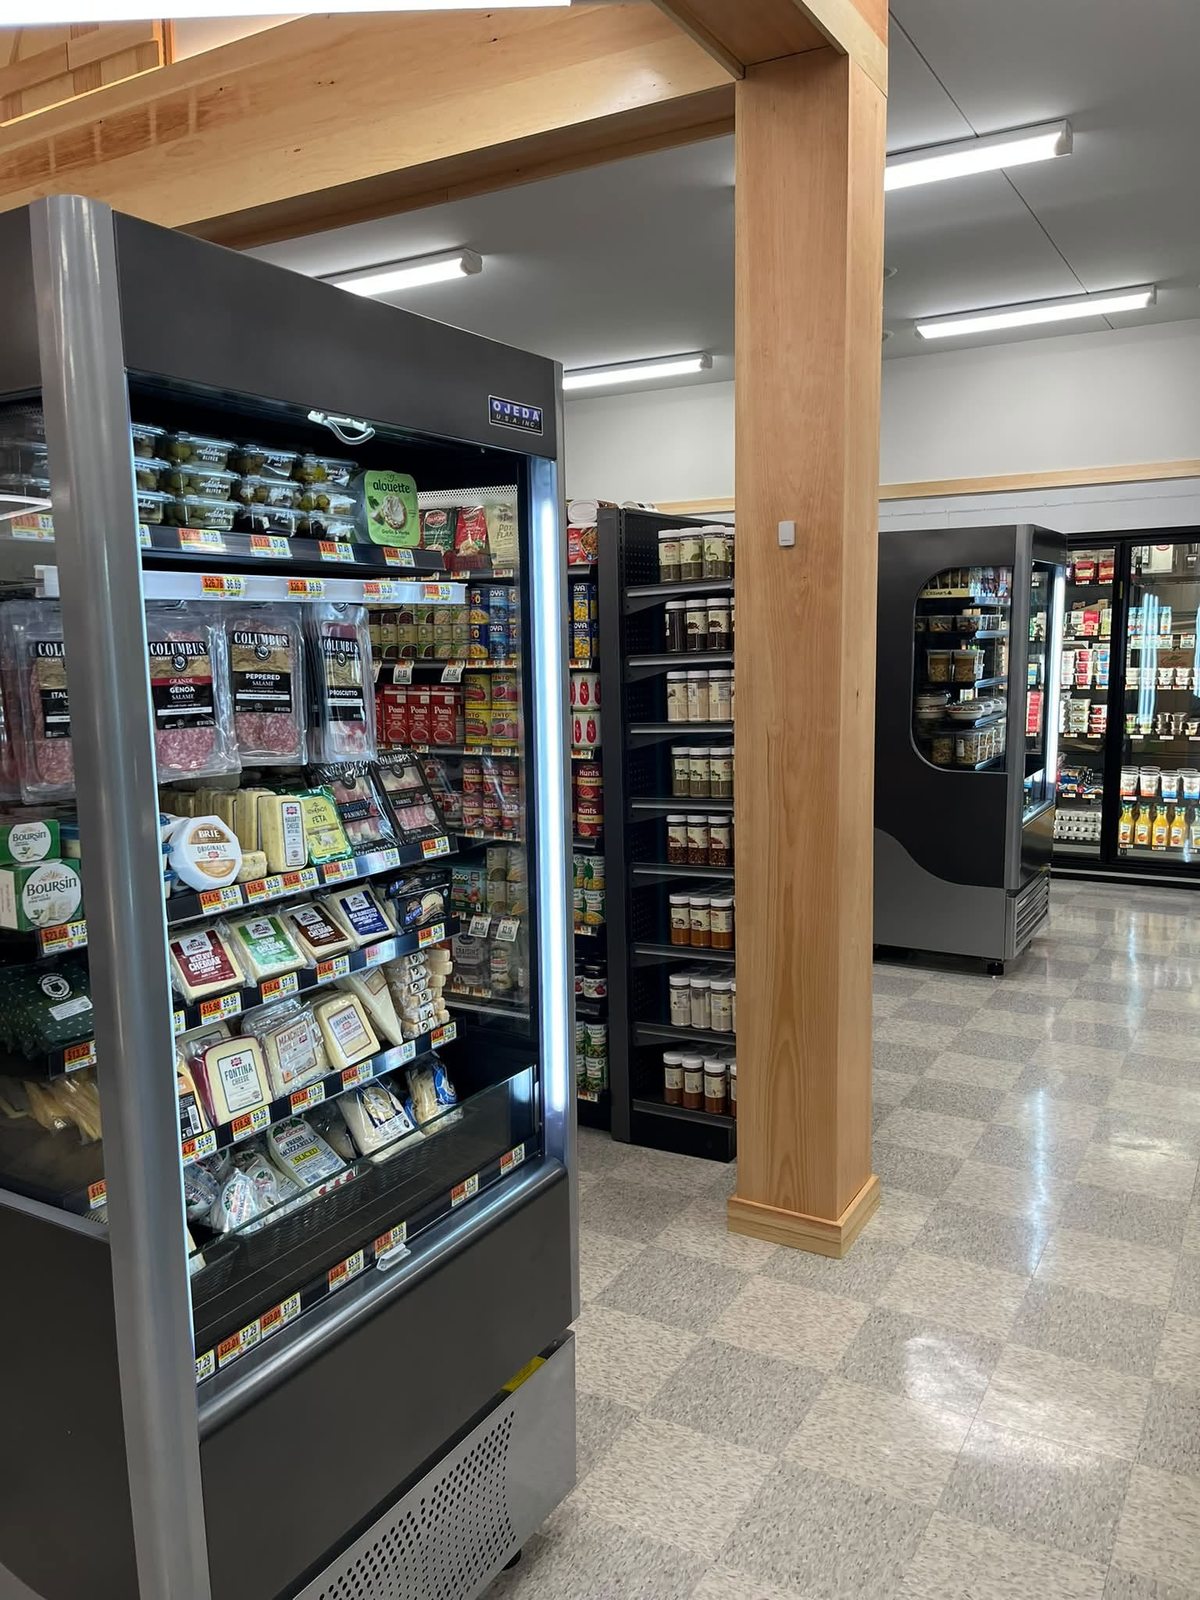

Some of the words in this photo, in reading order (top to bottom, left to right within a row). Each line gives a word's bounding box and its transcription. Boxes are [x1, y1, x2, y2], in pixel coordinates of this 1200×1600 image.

[492, 400, 540, 422] OJEDA
[372, 480, 411, 494] alouette
[234, 632, 289, 648] COLUMBUS
[150, 642, 206, 656] COLUMBUS
[312, 814, 328, 824] FETA
[197, 830, 221, 838] BRIE
[26, 876, 78, 897] Boursin
[308, 926, 334, 938] CHEDDAR
[188, 956, 222, 972] CHEDDAR
[190, 952, 214, 963] RESERVE
[223, 996, 237, 1008] $6.99
[224, 1063, 254, 1081] FONTINA
[253, 1112, 268, 1124] $9.29
[197, 1135, 214, 1147] $6.99
[280, 1134, 319, 1158] MOZZARELLA
[286, 1136, 304, 1147] FRESH
[294, 1148, 318, 1163] SLICED
[284, 1297, 298, 1314] $7.29
[220, 1338, 240, 1354] $22.01
[242, 1324, 258, 1342] $7.29
